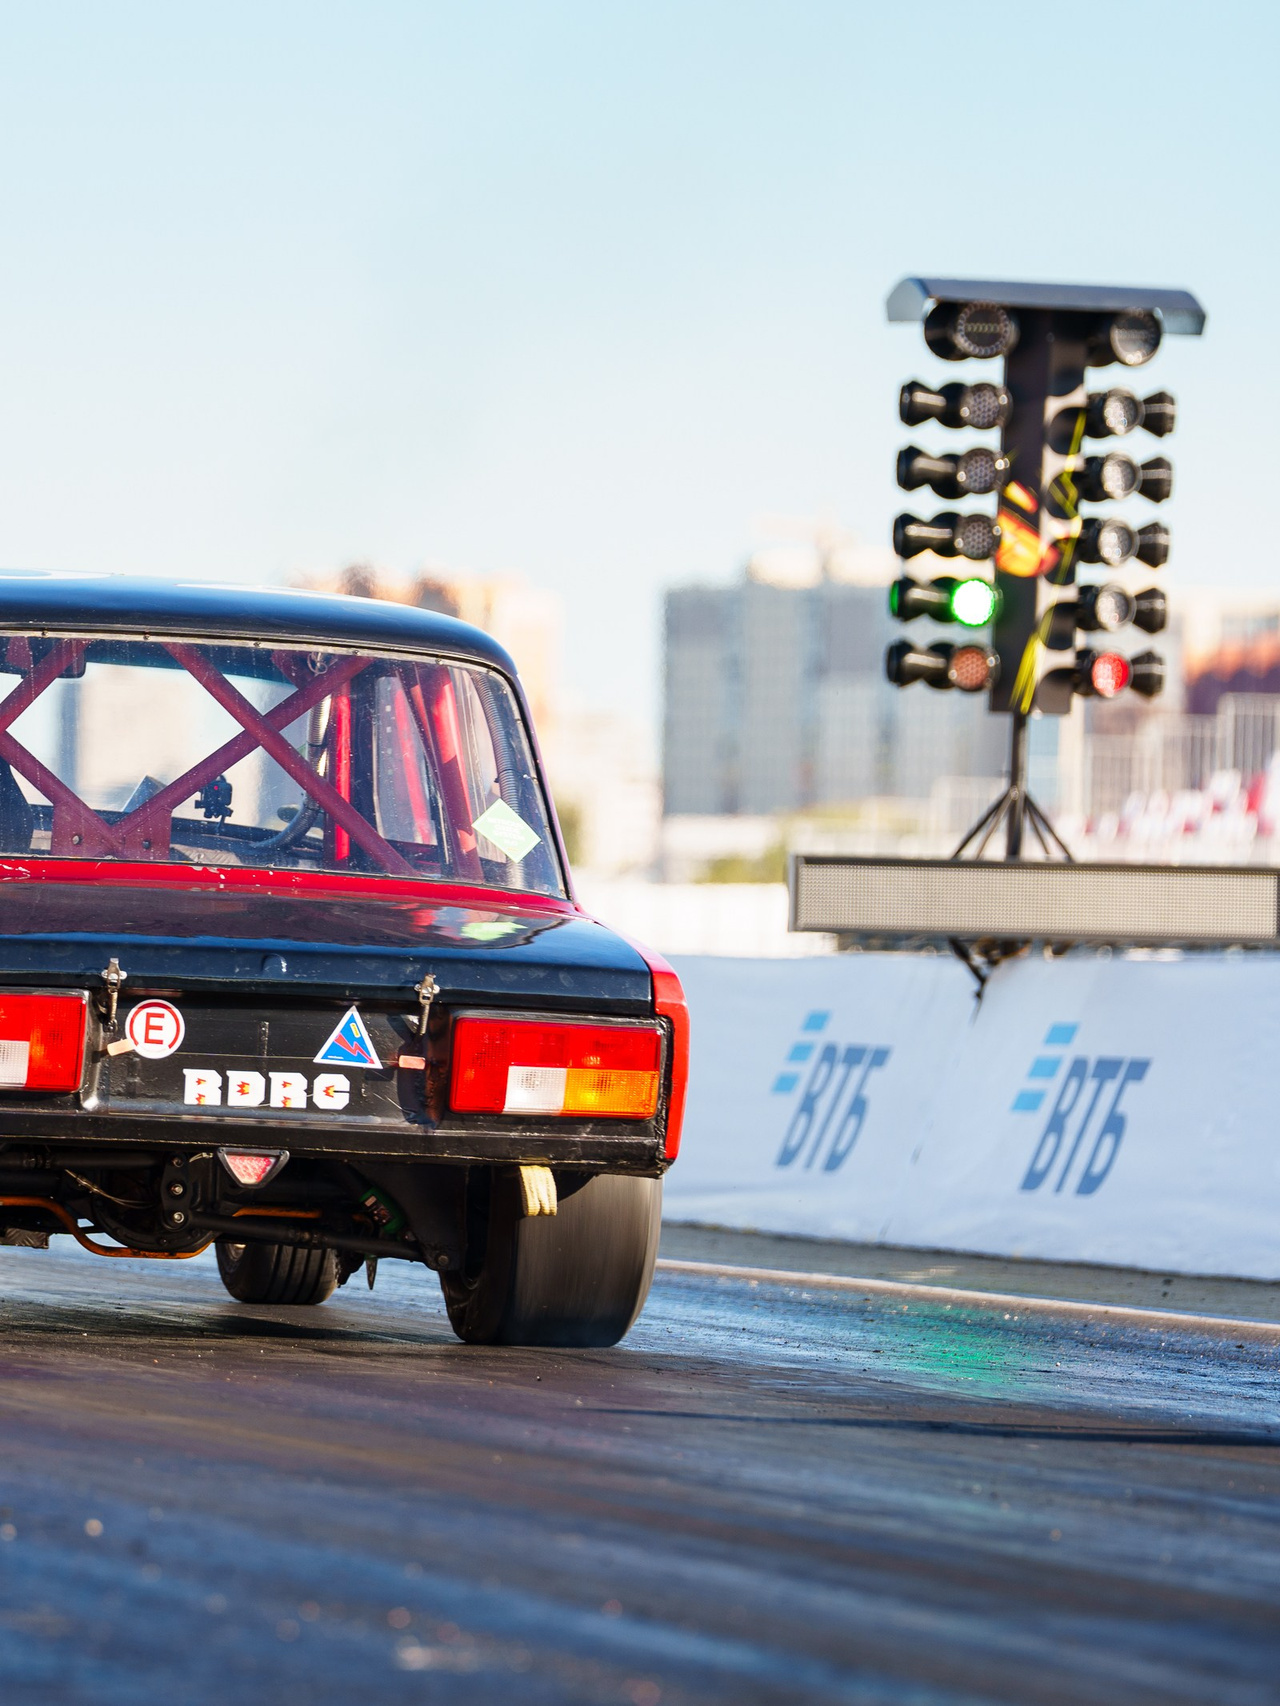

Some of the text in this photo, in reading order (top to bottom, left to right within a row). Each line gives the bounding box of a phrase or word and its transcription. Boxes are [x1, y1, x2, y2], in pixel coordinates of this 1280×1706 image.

[144, 1012, 165, 1045] E
[775, 1042, 891, 1172] ВТБ
[1020, 1056, 1151, 1196] ВТБ
